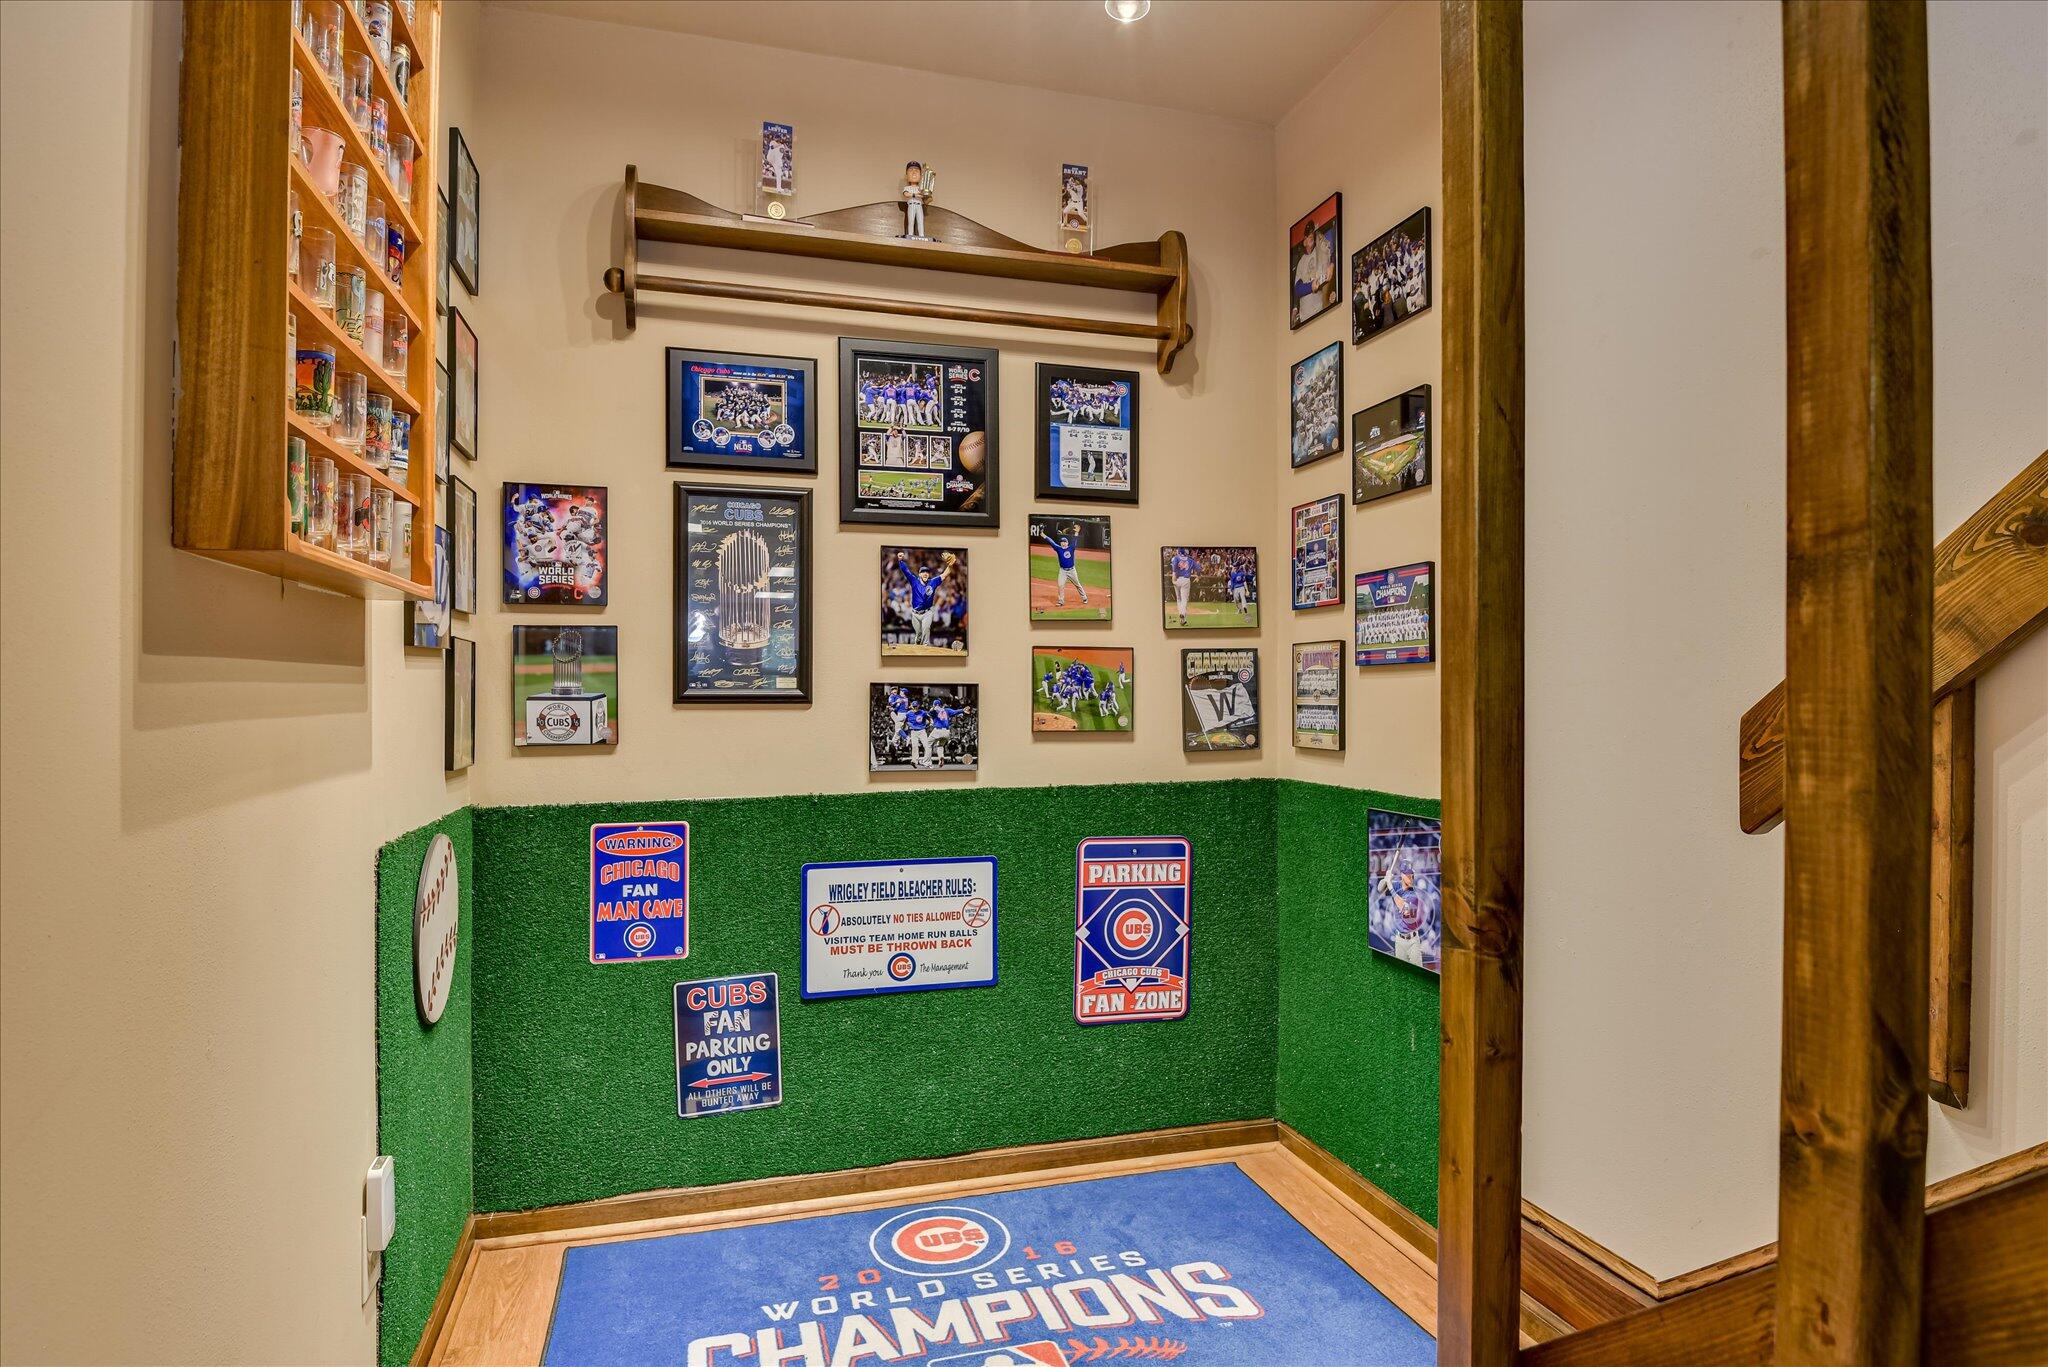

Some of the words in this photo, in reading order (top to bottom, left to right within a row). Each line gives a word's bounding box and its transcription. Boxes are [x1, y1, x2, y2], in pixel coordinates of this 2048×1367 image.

[724, 508, 764, 521] CUBS
[538, 566, 574, 575] WORLD
[538, 575, 574, 585] SERIES
[1376, 586, 1406, 600] CHAMPIONS
[1186, 652, 1254, 679] CHAMPIONS
[1206, 686, 1236, 722] W
[546, 718, 570, 727] CUBS
[604, 837, 676, 850] WARNING!
[600, 860, 680, 886] CHICAGO
[1088, 862, 1182, 884] PARKING
[622, 884, 658, 898] FAN
[828, 882, 868, 901] WRIGLEY
[871, 880, 896, 900] FIELD
[899, 878, 942, 898] BLEACHER
[946, 877, 976, 895] RULES:
[596, 900, 640, 922] MAN
[642, 898, 682, 920] CAVE
[840, 914, 891, 926] ABSOLUTELY
[893, 914, 904, 924] NO
[906, 912, 924, 922] TIES
[926, 910, 962, 922] ALLOWED
[824, 934, 866, 945] VISITING
[868, 932, 895, 942] TEAM
[898, 932, 924, 941] HOME
[928, 930, 946, 939] RUN
[950, 929, 978, 938] BALLS
[1114, 910, 1152, 949] CUBS
[830, 944, 864, 956] MUST
[868, 944, 884, 953] BE
[886, 940, 937, 952] THROWN
[940, 938, 972, 949] BACK
[842, 968, 867, 978] Thank
[868, 969, 884, 980] you
[892, 956, 912, 977] CUBS
[920, 964, 930, 973] The
[931, 961, 970, 975] Management
[1102, 968, 1138, 980] CHICAGO
[1140, 968, 1162, 976] CUBS
[686, 980, 767, 1010] CUBS
[1082, 992, 1126, 1014] FAN
[1134, 989, 1182, 1011] ZONE
[703, 1008, 751, 1036] FAN
[686, 1034, 770, 1060] PARKING
[706, 1056, 752, 1076] ONLY
[688, 1092, 703, 1100] ALL
[705, 1086, 738, 1098] OTHERS
[740, 1083, 759, 1093] WILL
[762, 1082, 772, 1090] BE
[702, 1095, 734, 1108] BUNTED
[736, 1092, 760, 1102] AWAY
[896, 1218, 985, 1262] CUBS
[761, 1279, 946, 1321] WORLD
[972, 1250, 1148, 1290] SERIES
[687, 1261, 1264, 1367] CHAMPIONS
